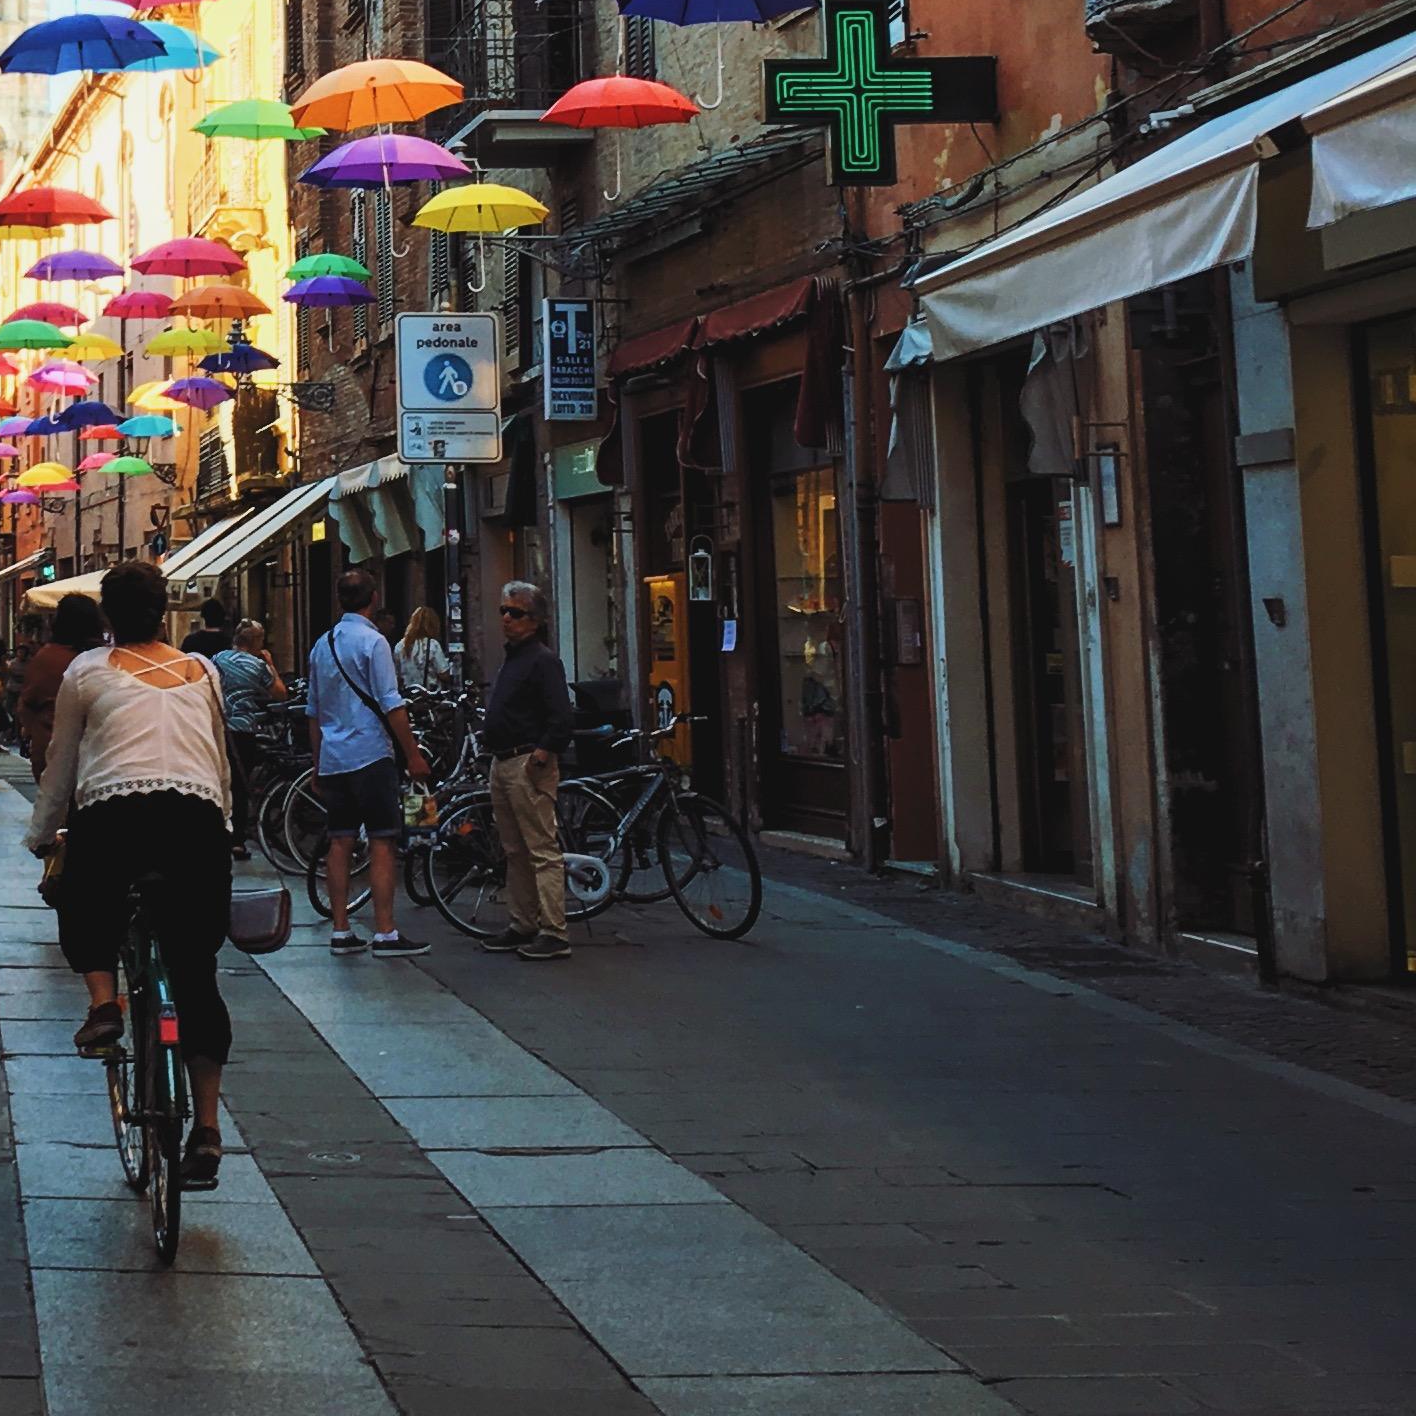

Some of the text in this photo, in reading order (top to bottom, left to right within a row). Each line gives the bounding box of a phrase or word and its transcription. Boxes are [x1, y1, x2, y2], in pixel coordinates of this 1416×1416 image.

[432, 323, 461, 332] area
[555, 304, 587, 353] T
[417, 337, 478, 349] pedonale
[578, 339, 592, 350] 21
[556, 356, 581, 364] SALI
[553, 404, 575, 414] LOTTO
